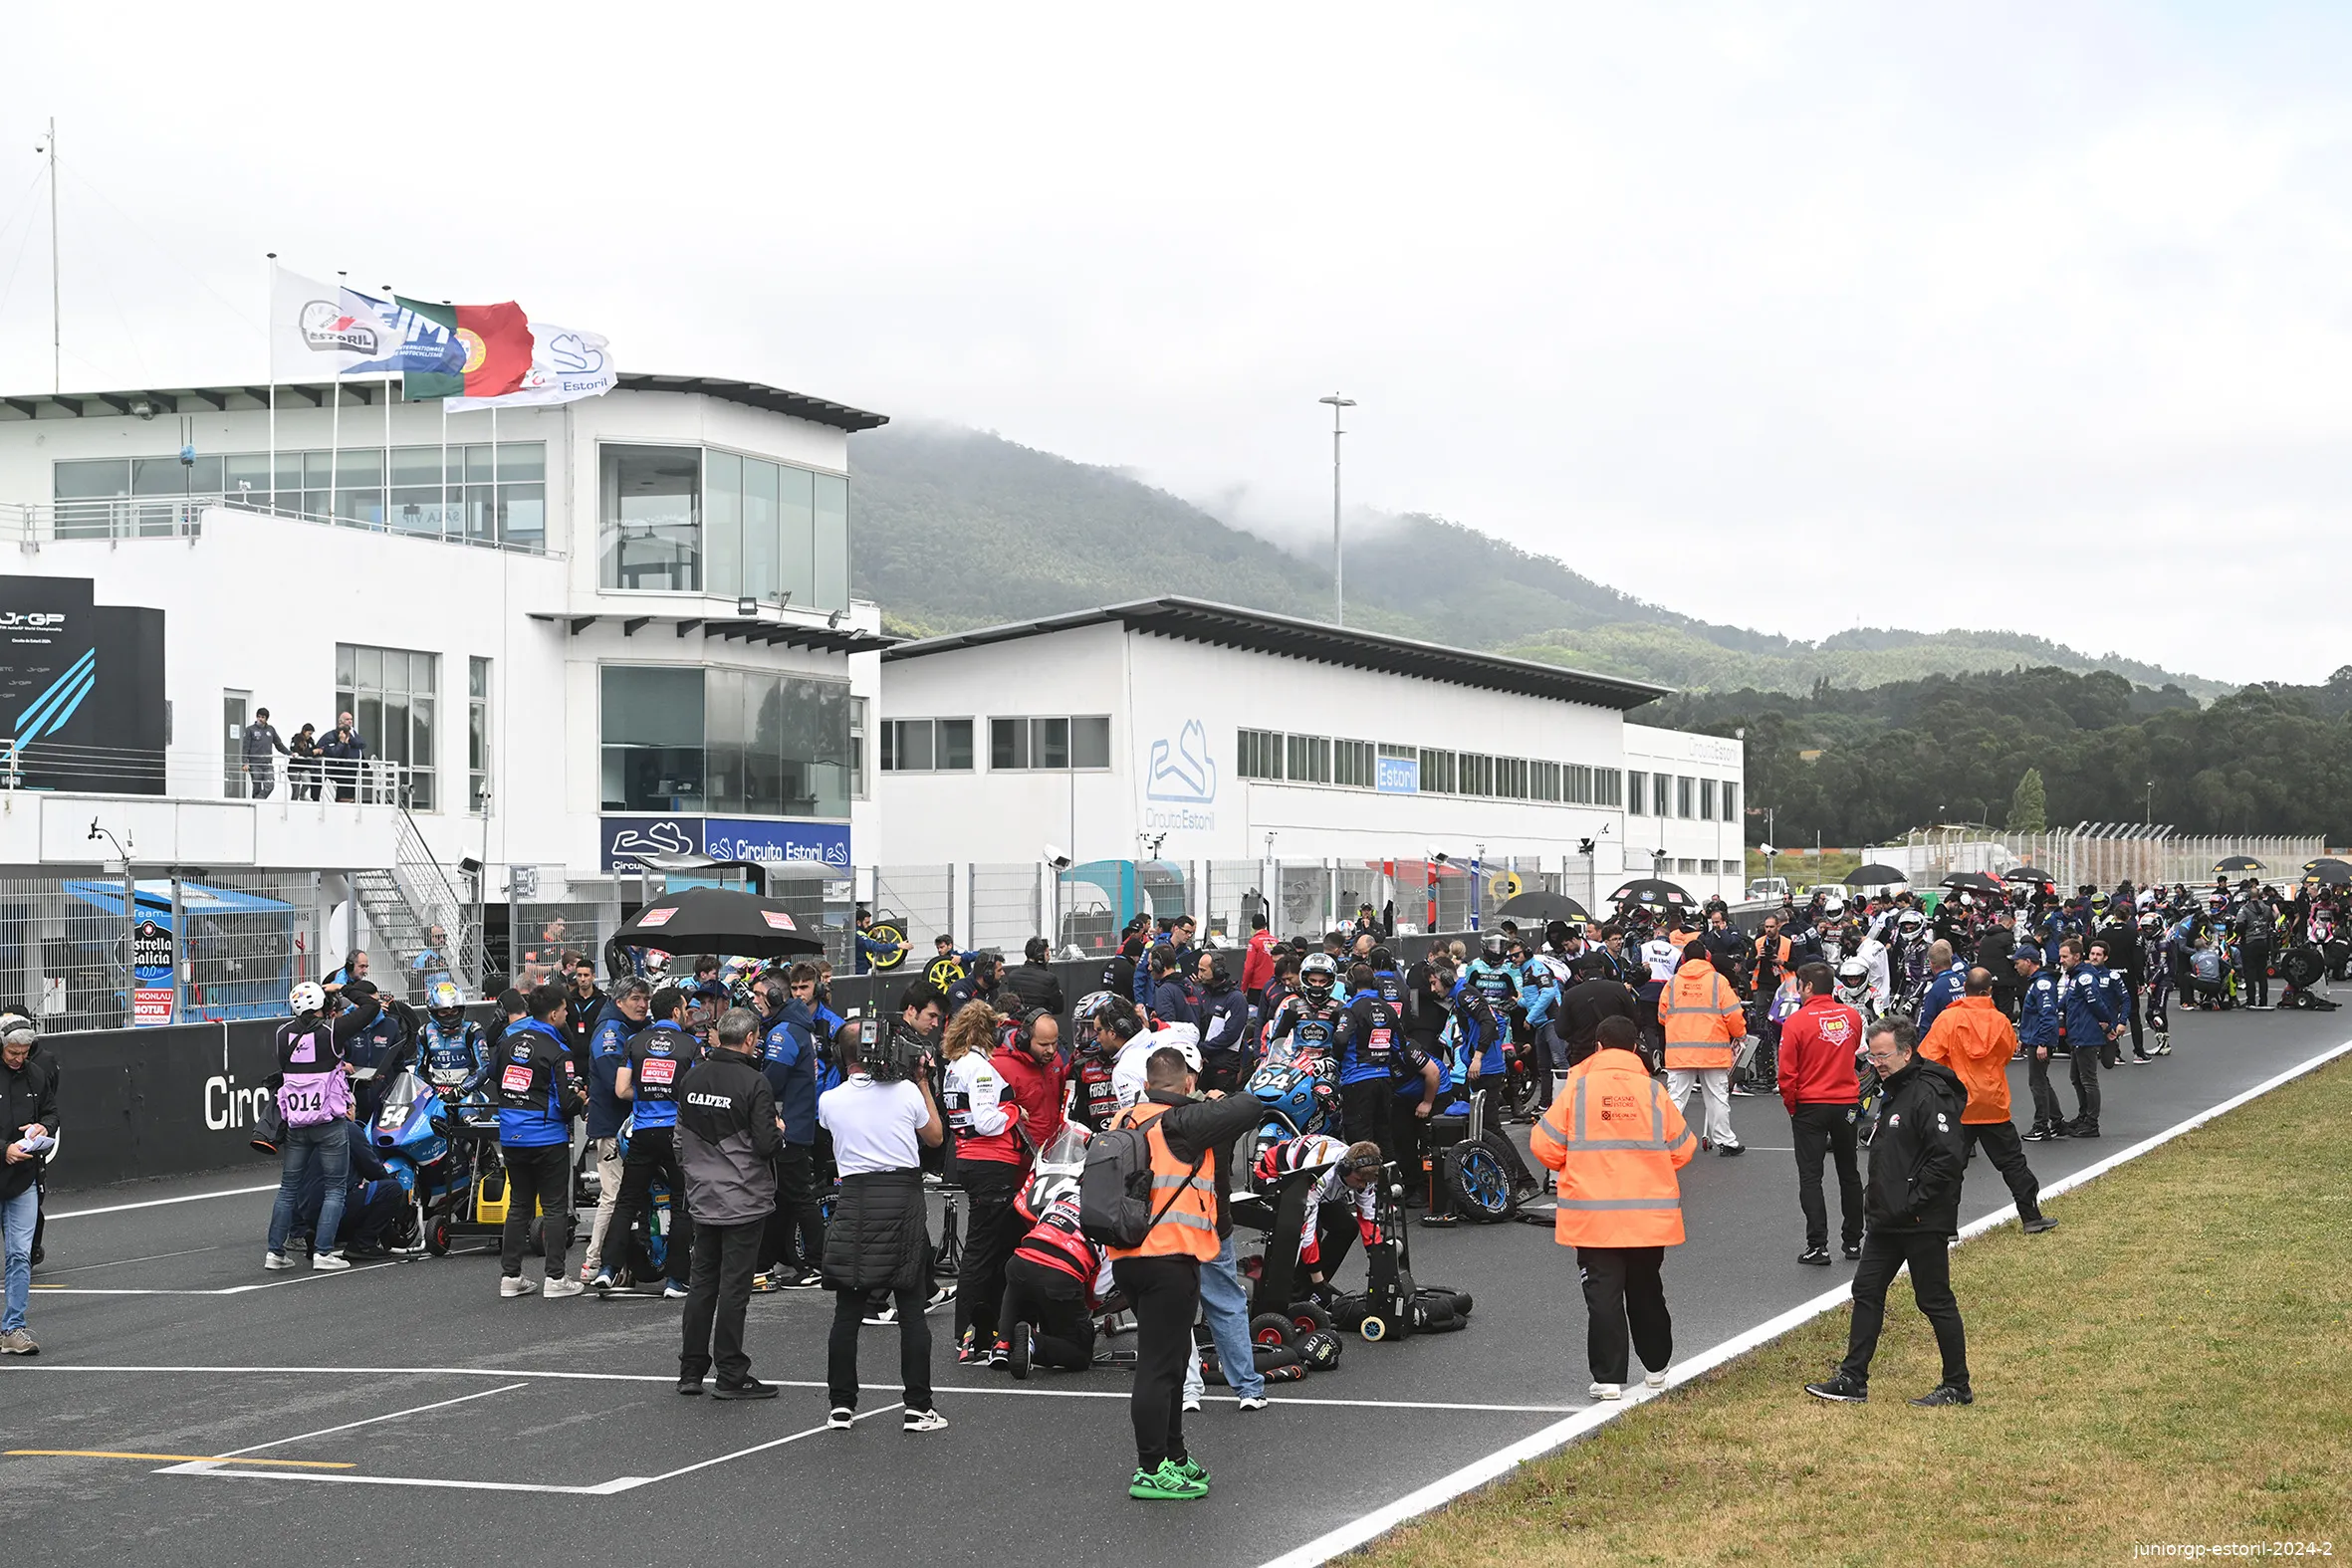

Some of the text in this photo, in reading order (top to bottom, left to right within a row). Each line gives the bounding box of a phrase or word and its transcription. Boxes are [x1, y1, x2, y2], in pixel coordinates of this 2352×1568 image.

[310, 332, 372, 346] ESTORIL
[563, 378, 607, 391] Estoril
[1379, 763, 1416, 787] Estoril
[736, 839, 823, 861] Circuito Estoril
[134, 938, 172, 952] strella
[1778, 1003, 1800, 1017] 11
[1253, 1071, 1291, 1090] 94
[288, 1092, 322, 1111] 014
[378, 1105, 409, 1127] 54
[1032, 1176, 1081, 1207] 14
